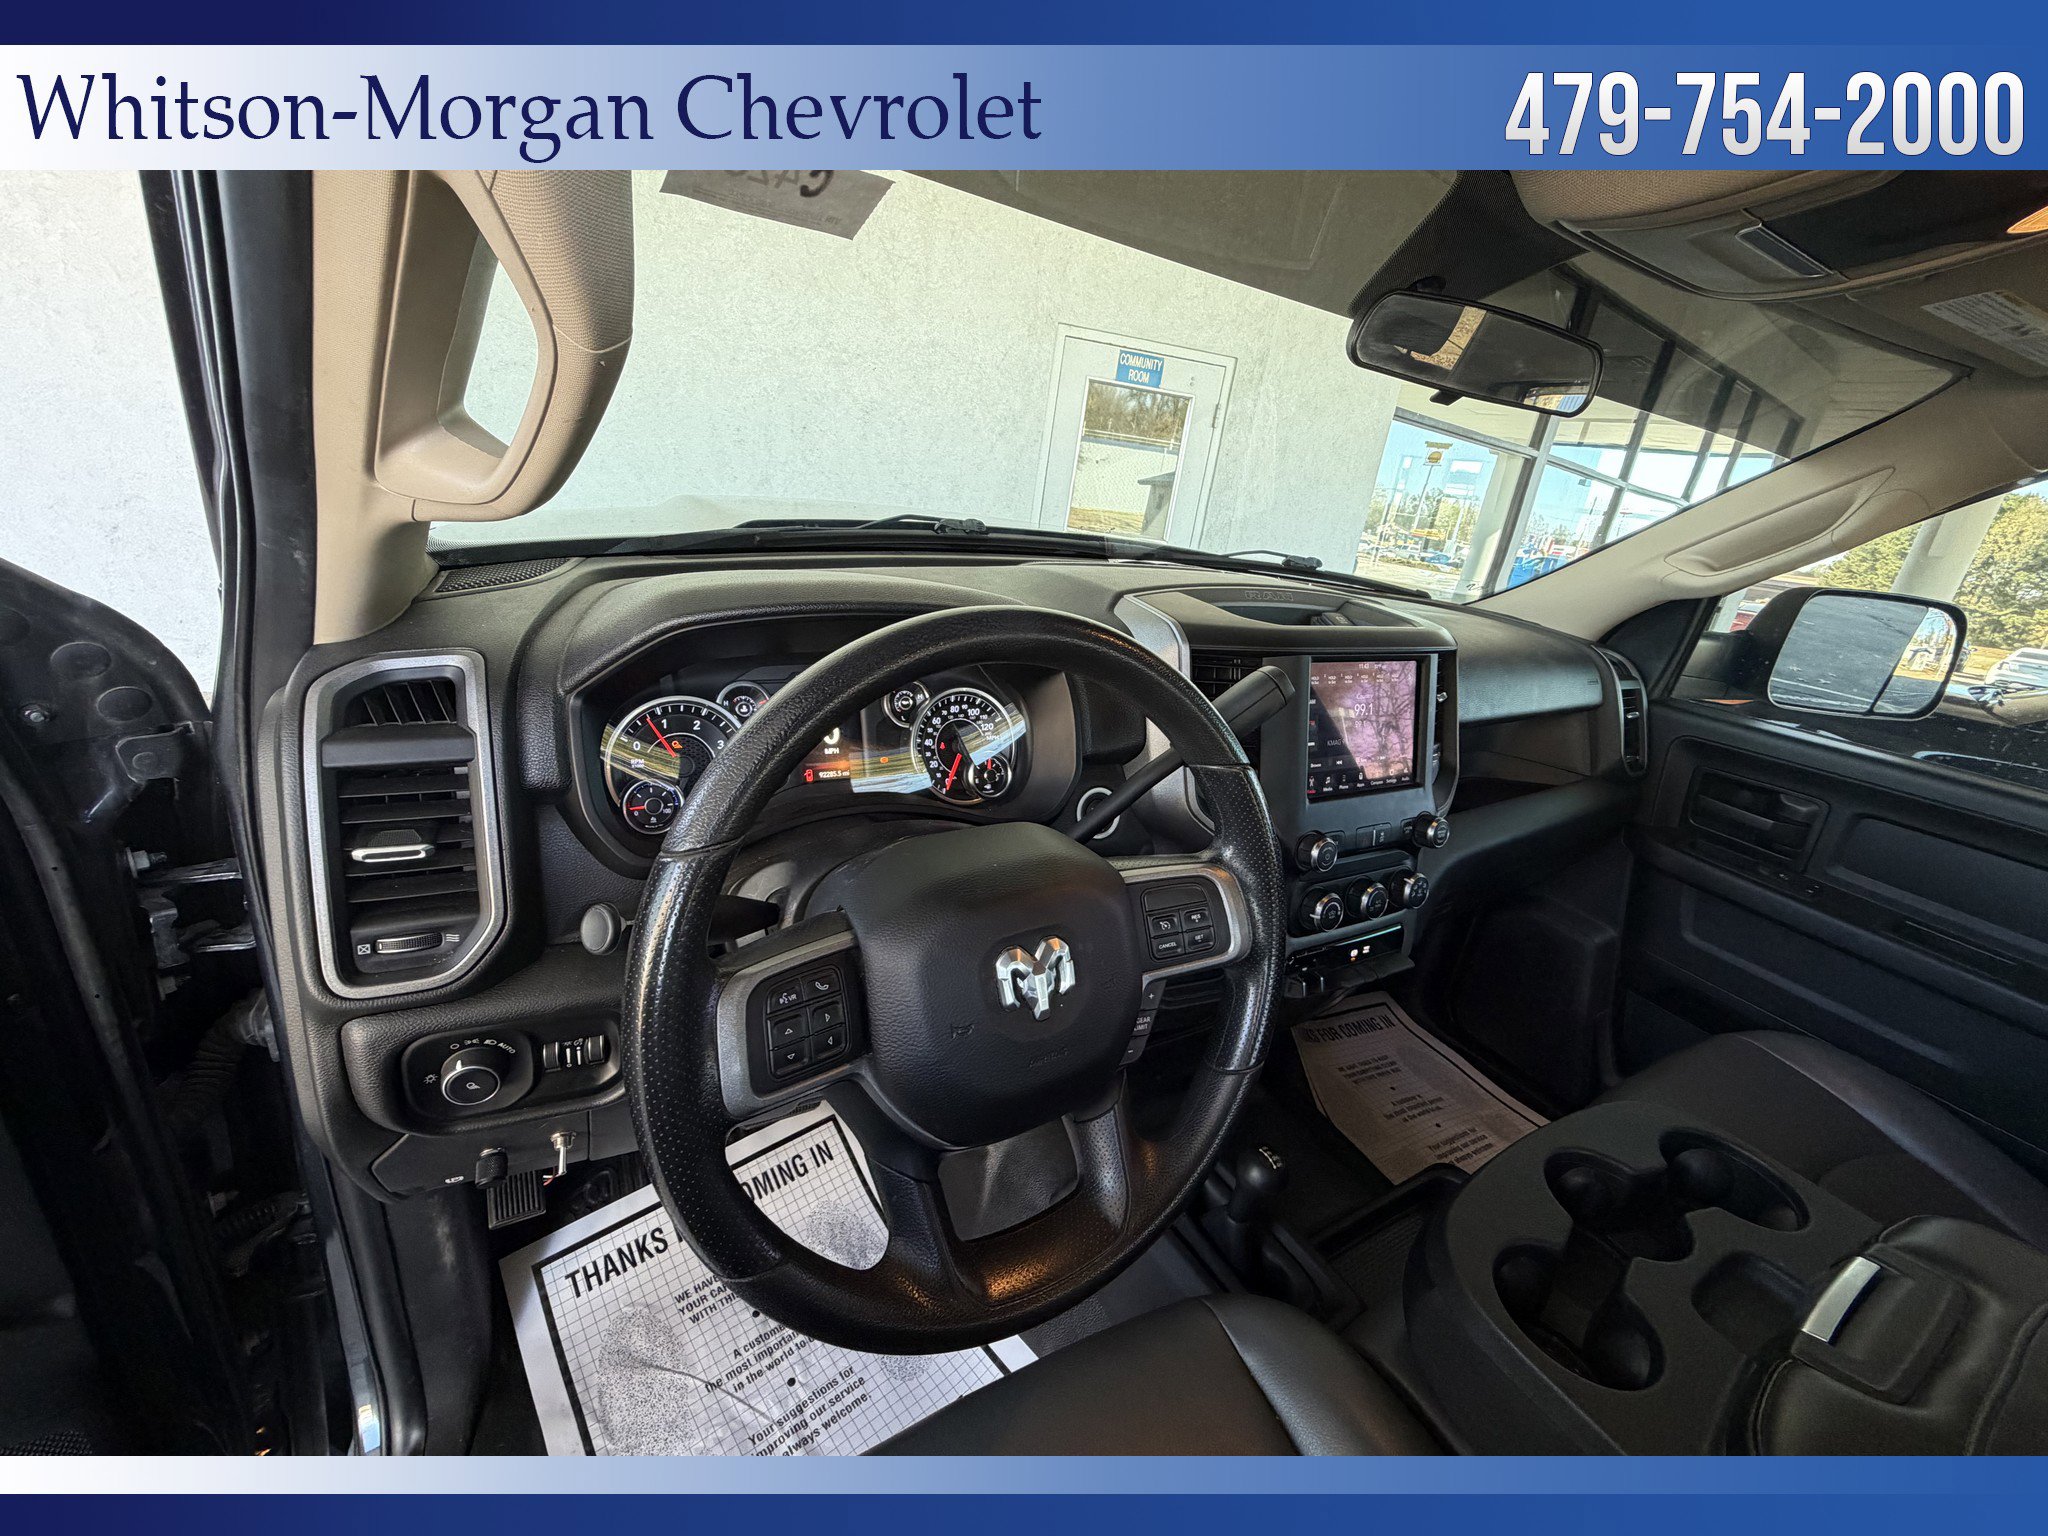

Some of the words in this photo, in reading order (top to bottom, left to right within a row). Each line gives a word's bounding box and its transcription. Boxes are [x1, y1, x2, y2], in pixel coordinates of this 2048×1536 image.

[1120, 353, 1163, 372] COMMUNITY
[1128, 368, 1150, 384] ROOM
[950, 705, 960, 713] 80
[967, 708, 980, 717] 100
[1354, 702, 1374, 716] 99.1
[661, 719, 668, 729] 1
[693, 720, 701, 731] 2
[932, 717, 942, 725] 60
[981, 722, 994, 731] 120
[633, 741, 641, 751] 0
[717, 740, 725, 750] 3
[924, 738, 934, 746] 40
[929, 760, 938, 768] 20
[1158, 942, 1177, 950] CANCEL
[788, 994, 798, 1002] VR
[1317, 1025, 1343, 1042] FOR
[1339, 1017, 1384, 1038] COMING
[1378, 1014, 1396, 1029] IN
[497, 1042, 516, 1055] AUTO
[811, 1140, 835, 1172] IN
[564, 1227, 669, 1299] THANKS
[674, 1288, 692, 1304] WE
[678, 1294, 708, 1316] YOUR
[688, 1303, 718, 1324] WITH
[732, 1349, 742, 1360] A
[744, 1325, 787, 1354] custome
[732, 1381, 744, 1394] in
[746, 1368, 764, 1388] the
[766, 1347, 795, 1373] world
[795, 1338, 807, 1352] to
[704, 1378, 724, 1394] the
[725, 1360, 753, 1382] most
[748, 1424, 776, 1447] Your
[776, 1376, 840, 1428] suggestions
[838, 1365, 856, 1382] for
[821, 1392, 873, 1432] welcome.
[751, 1418, 809, 1457] mproving
[810, 1405, 828, 1422] our
[828, 1376, 867, 1408] service
